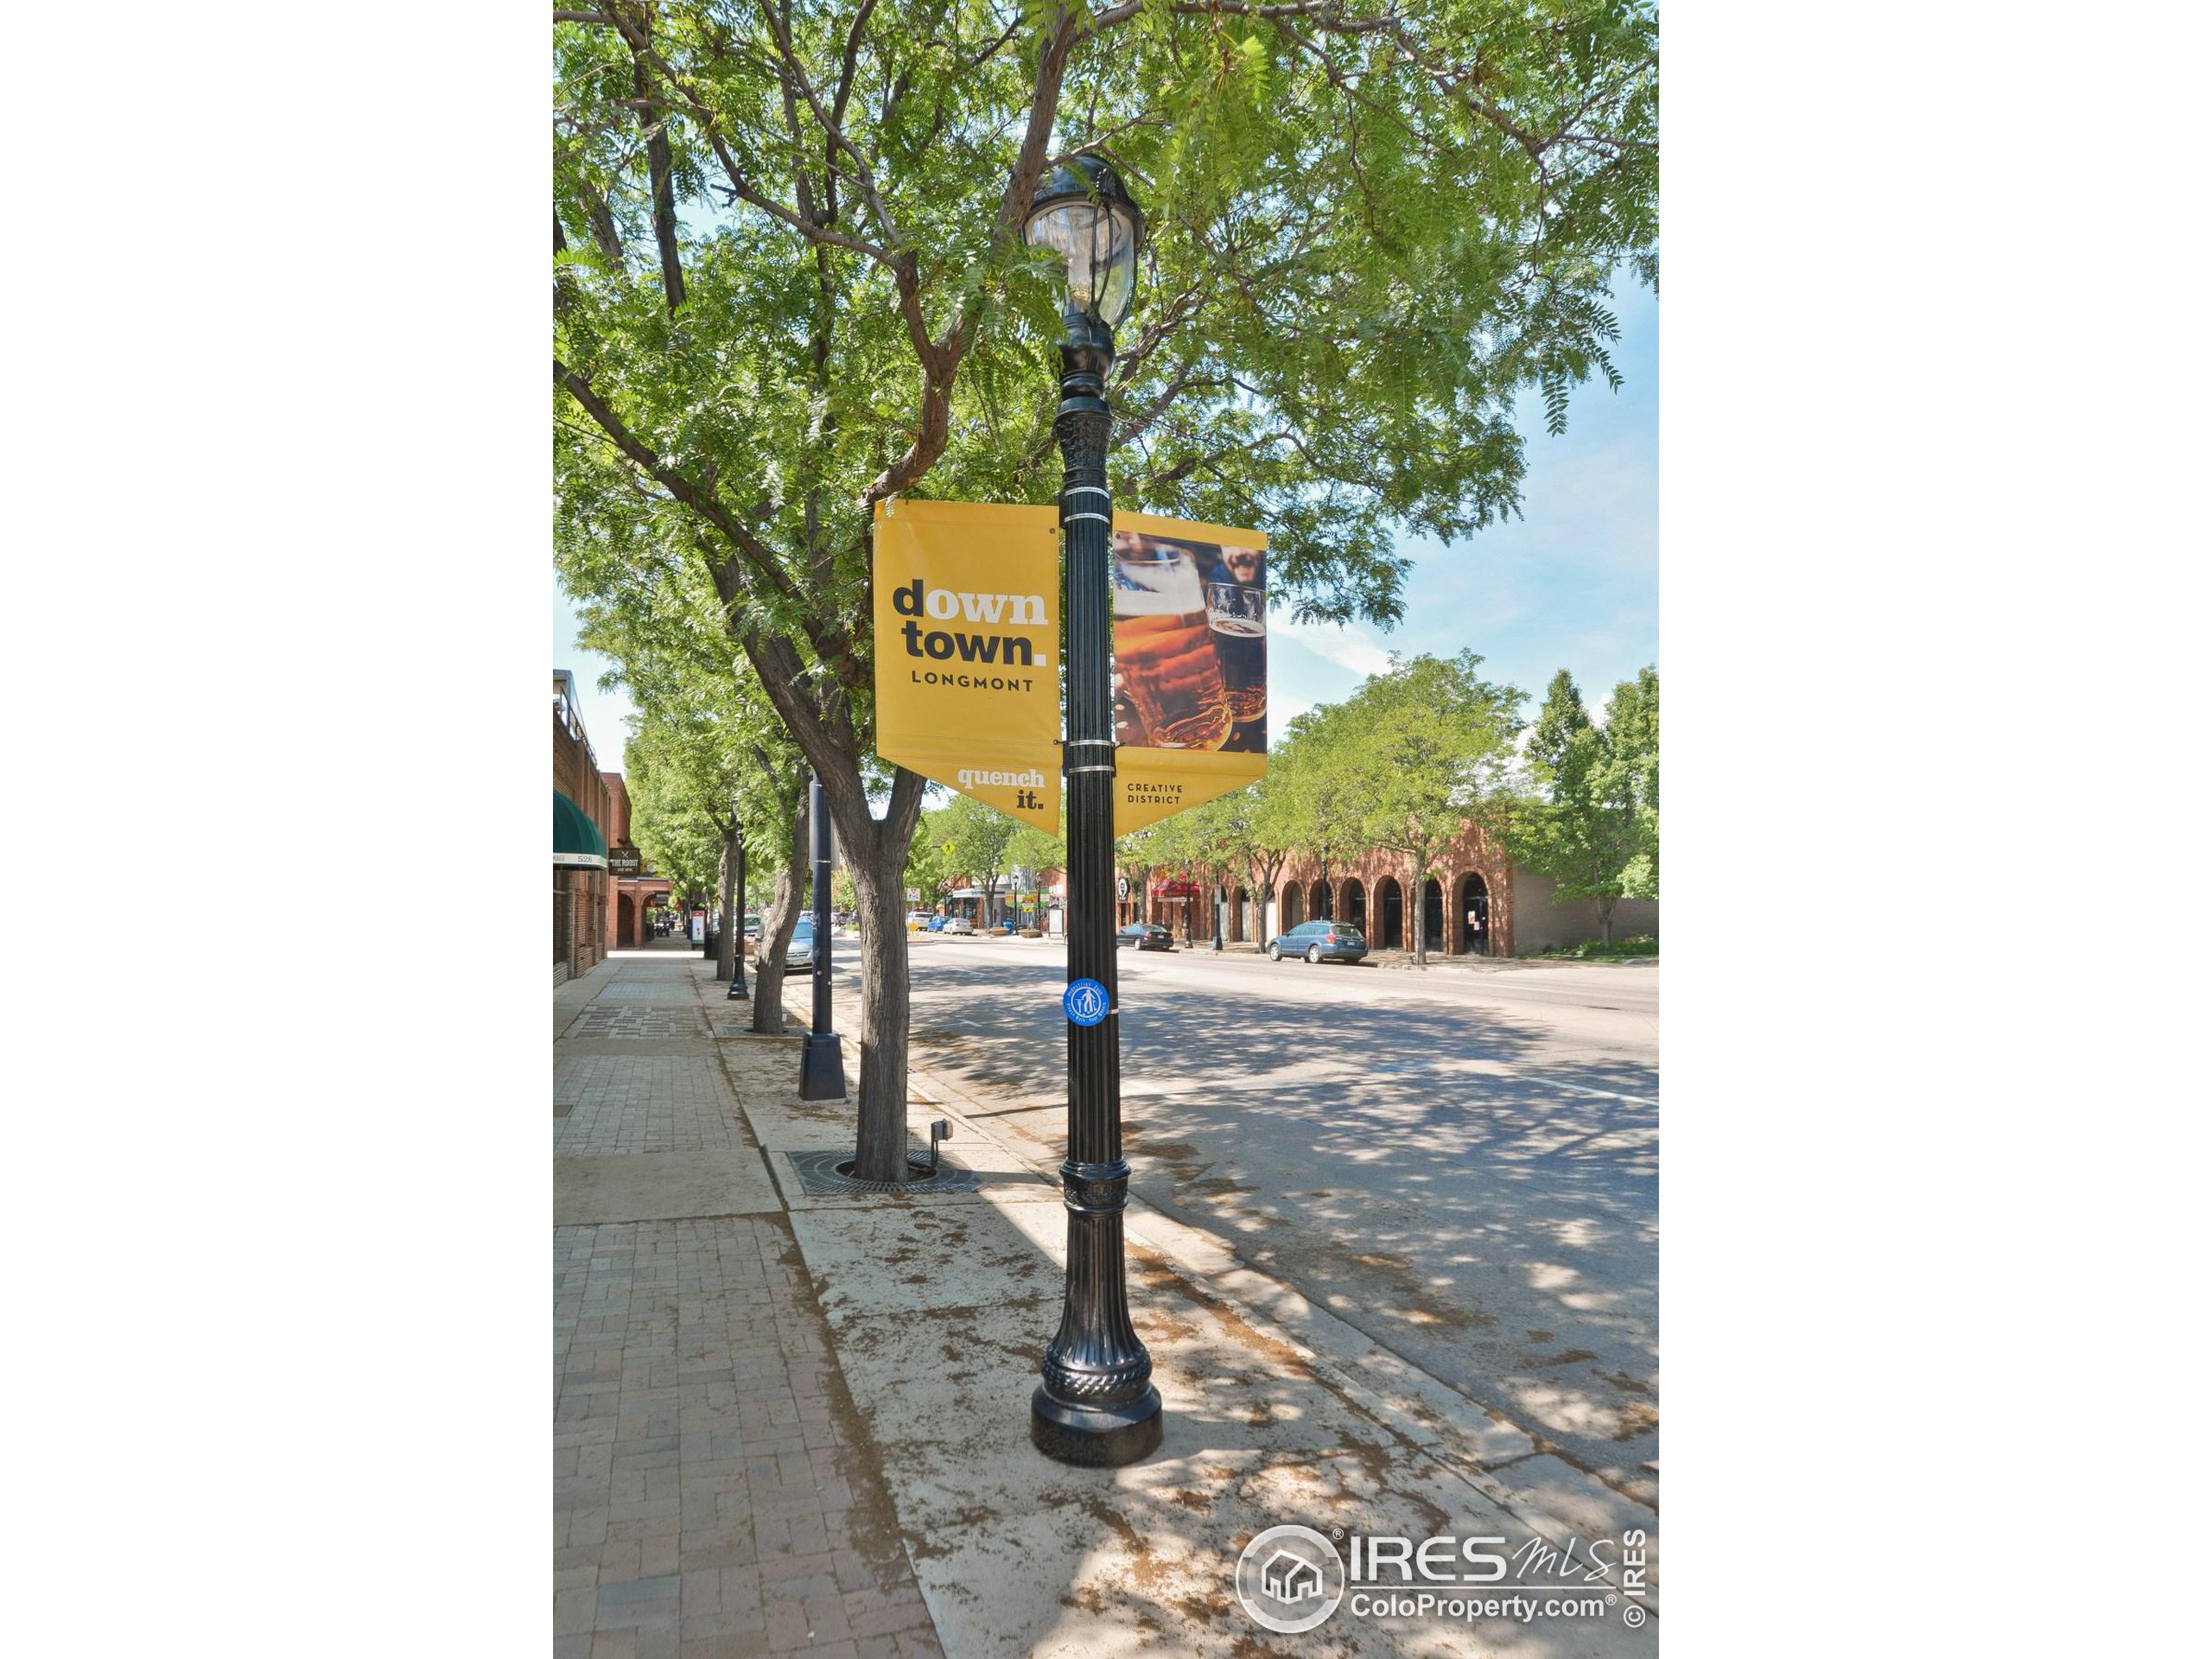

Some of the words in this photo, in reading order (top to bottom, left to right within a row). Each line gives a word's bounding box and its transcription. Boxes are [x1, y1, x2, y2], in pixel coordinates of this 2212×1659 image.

[893, 578, 1049, 626] down
[901, 620, 1046, 666] town.
[912, 670, 1033, 692] LONGMONT
[957, 768, 1046, 790] quench
[1127, 783, 1183, 793] CREATIVE
[1016, 789, 1044, 810] it.
[1128, 794, 1181, 804] DISTRICT
